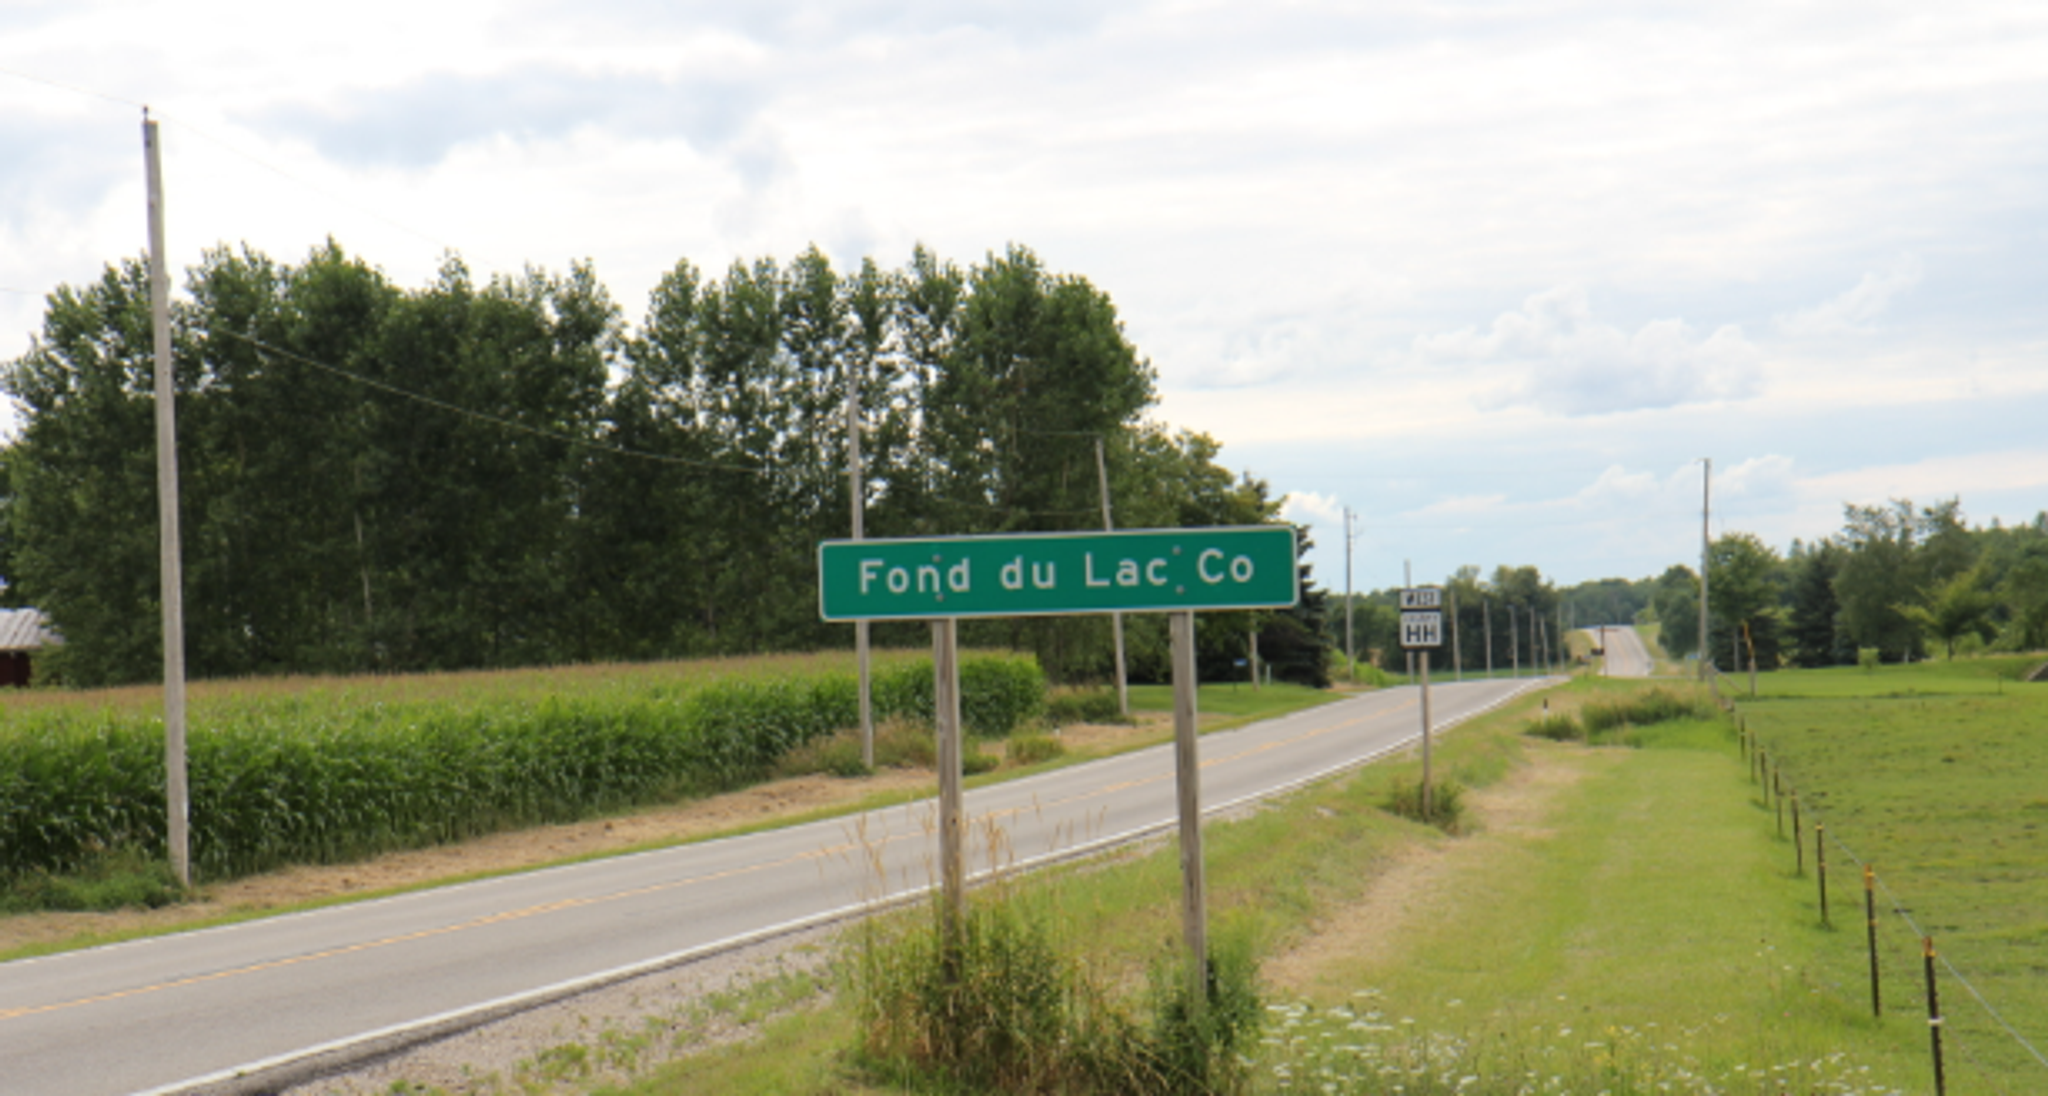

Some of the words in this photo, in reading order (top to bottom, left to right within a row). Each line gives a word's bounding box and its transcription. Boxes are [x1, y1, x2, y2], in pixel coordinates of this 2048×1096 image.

[860, 558, 970, 594] Fond
[1000, 557, 1056, 590] du
[1085, 553, 1168, 587] Lac
[1197, 548, 1254, 584] Co
[1406, 624, 1438, 643] HH
